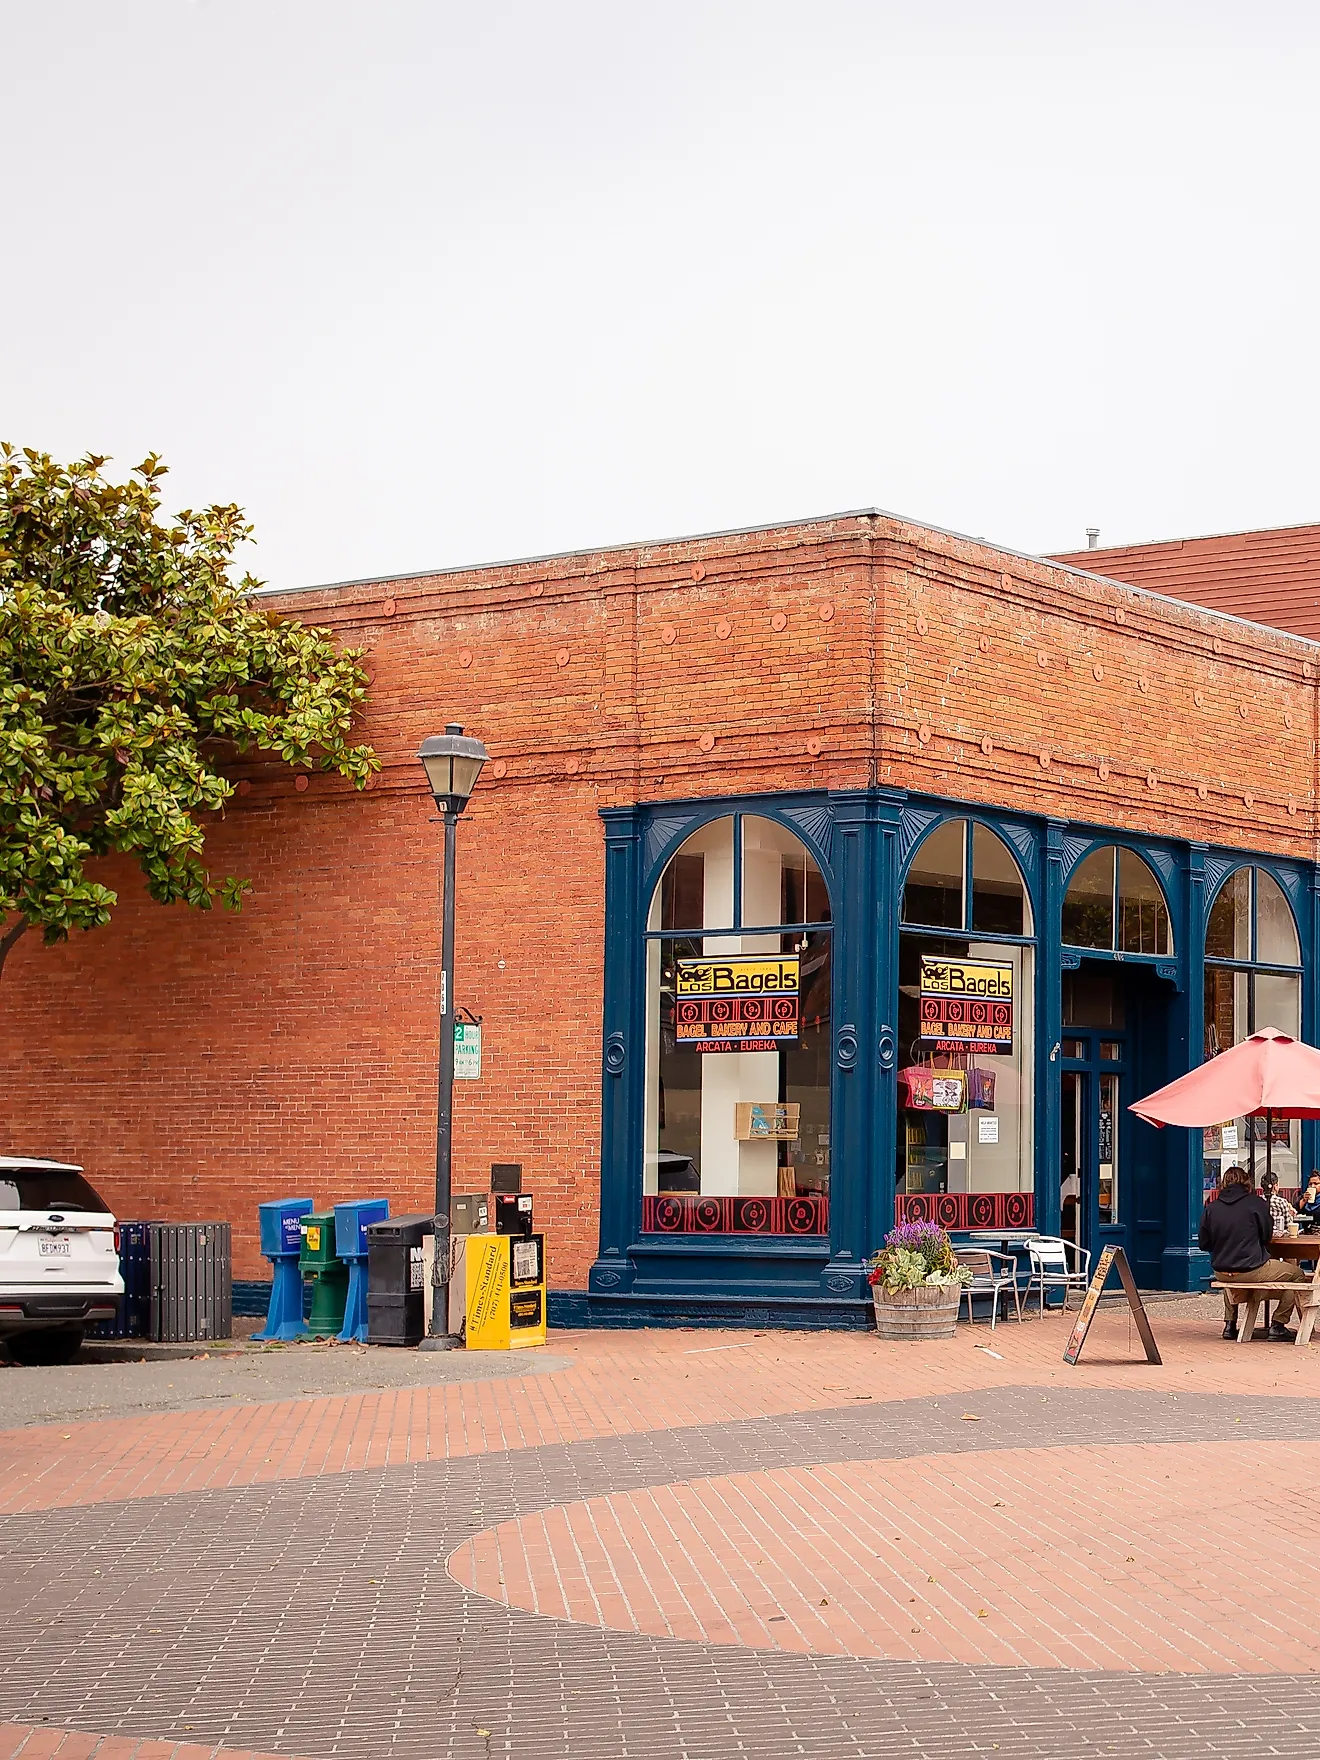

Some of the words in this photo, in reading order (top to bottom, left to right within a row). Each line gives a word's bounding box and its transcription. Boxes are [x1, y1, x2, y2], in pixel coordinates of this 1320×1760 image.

[679, 982, 712, 992] LOS
[713, 964, 797, 993] Bagels
[923, 979, 948, 990] LOS
[949, 968, 1010, 996] Bagels
[455, 1027, 463, 1039] 2
[465, 1029, 479, 1040] HOUR
[677, 1024, 707, 1037] BAGEL
[711, 1022, 747, 1037] BAKERY
[749, 1022, 771, 1036] AND
[773, 1021, 798, 1035] CAFE
[921, 1021, 945, 1036] BAGEL
[948, 1023, 976, 1037] BAKERY
[977, 1025, 993, 1038] AND
[994, 1026, 1011, 1039] CAFE
[455, 1045, 479, 1055] PARKING
[696, 1041, 731, 1052] ARCATA
[740, 1040, 777, 1051] EUREKA
[936, 1040, 964, 1051] ARCATA
[970, 1042, 997, 1053] EUREKA
[283, 1217, 300, 1227] MENU
